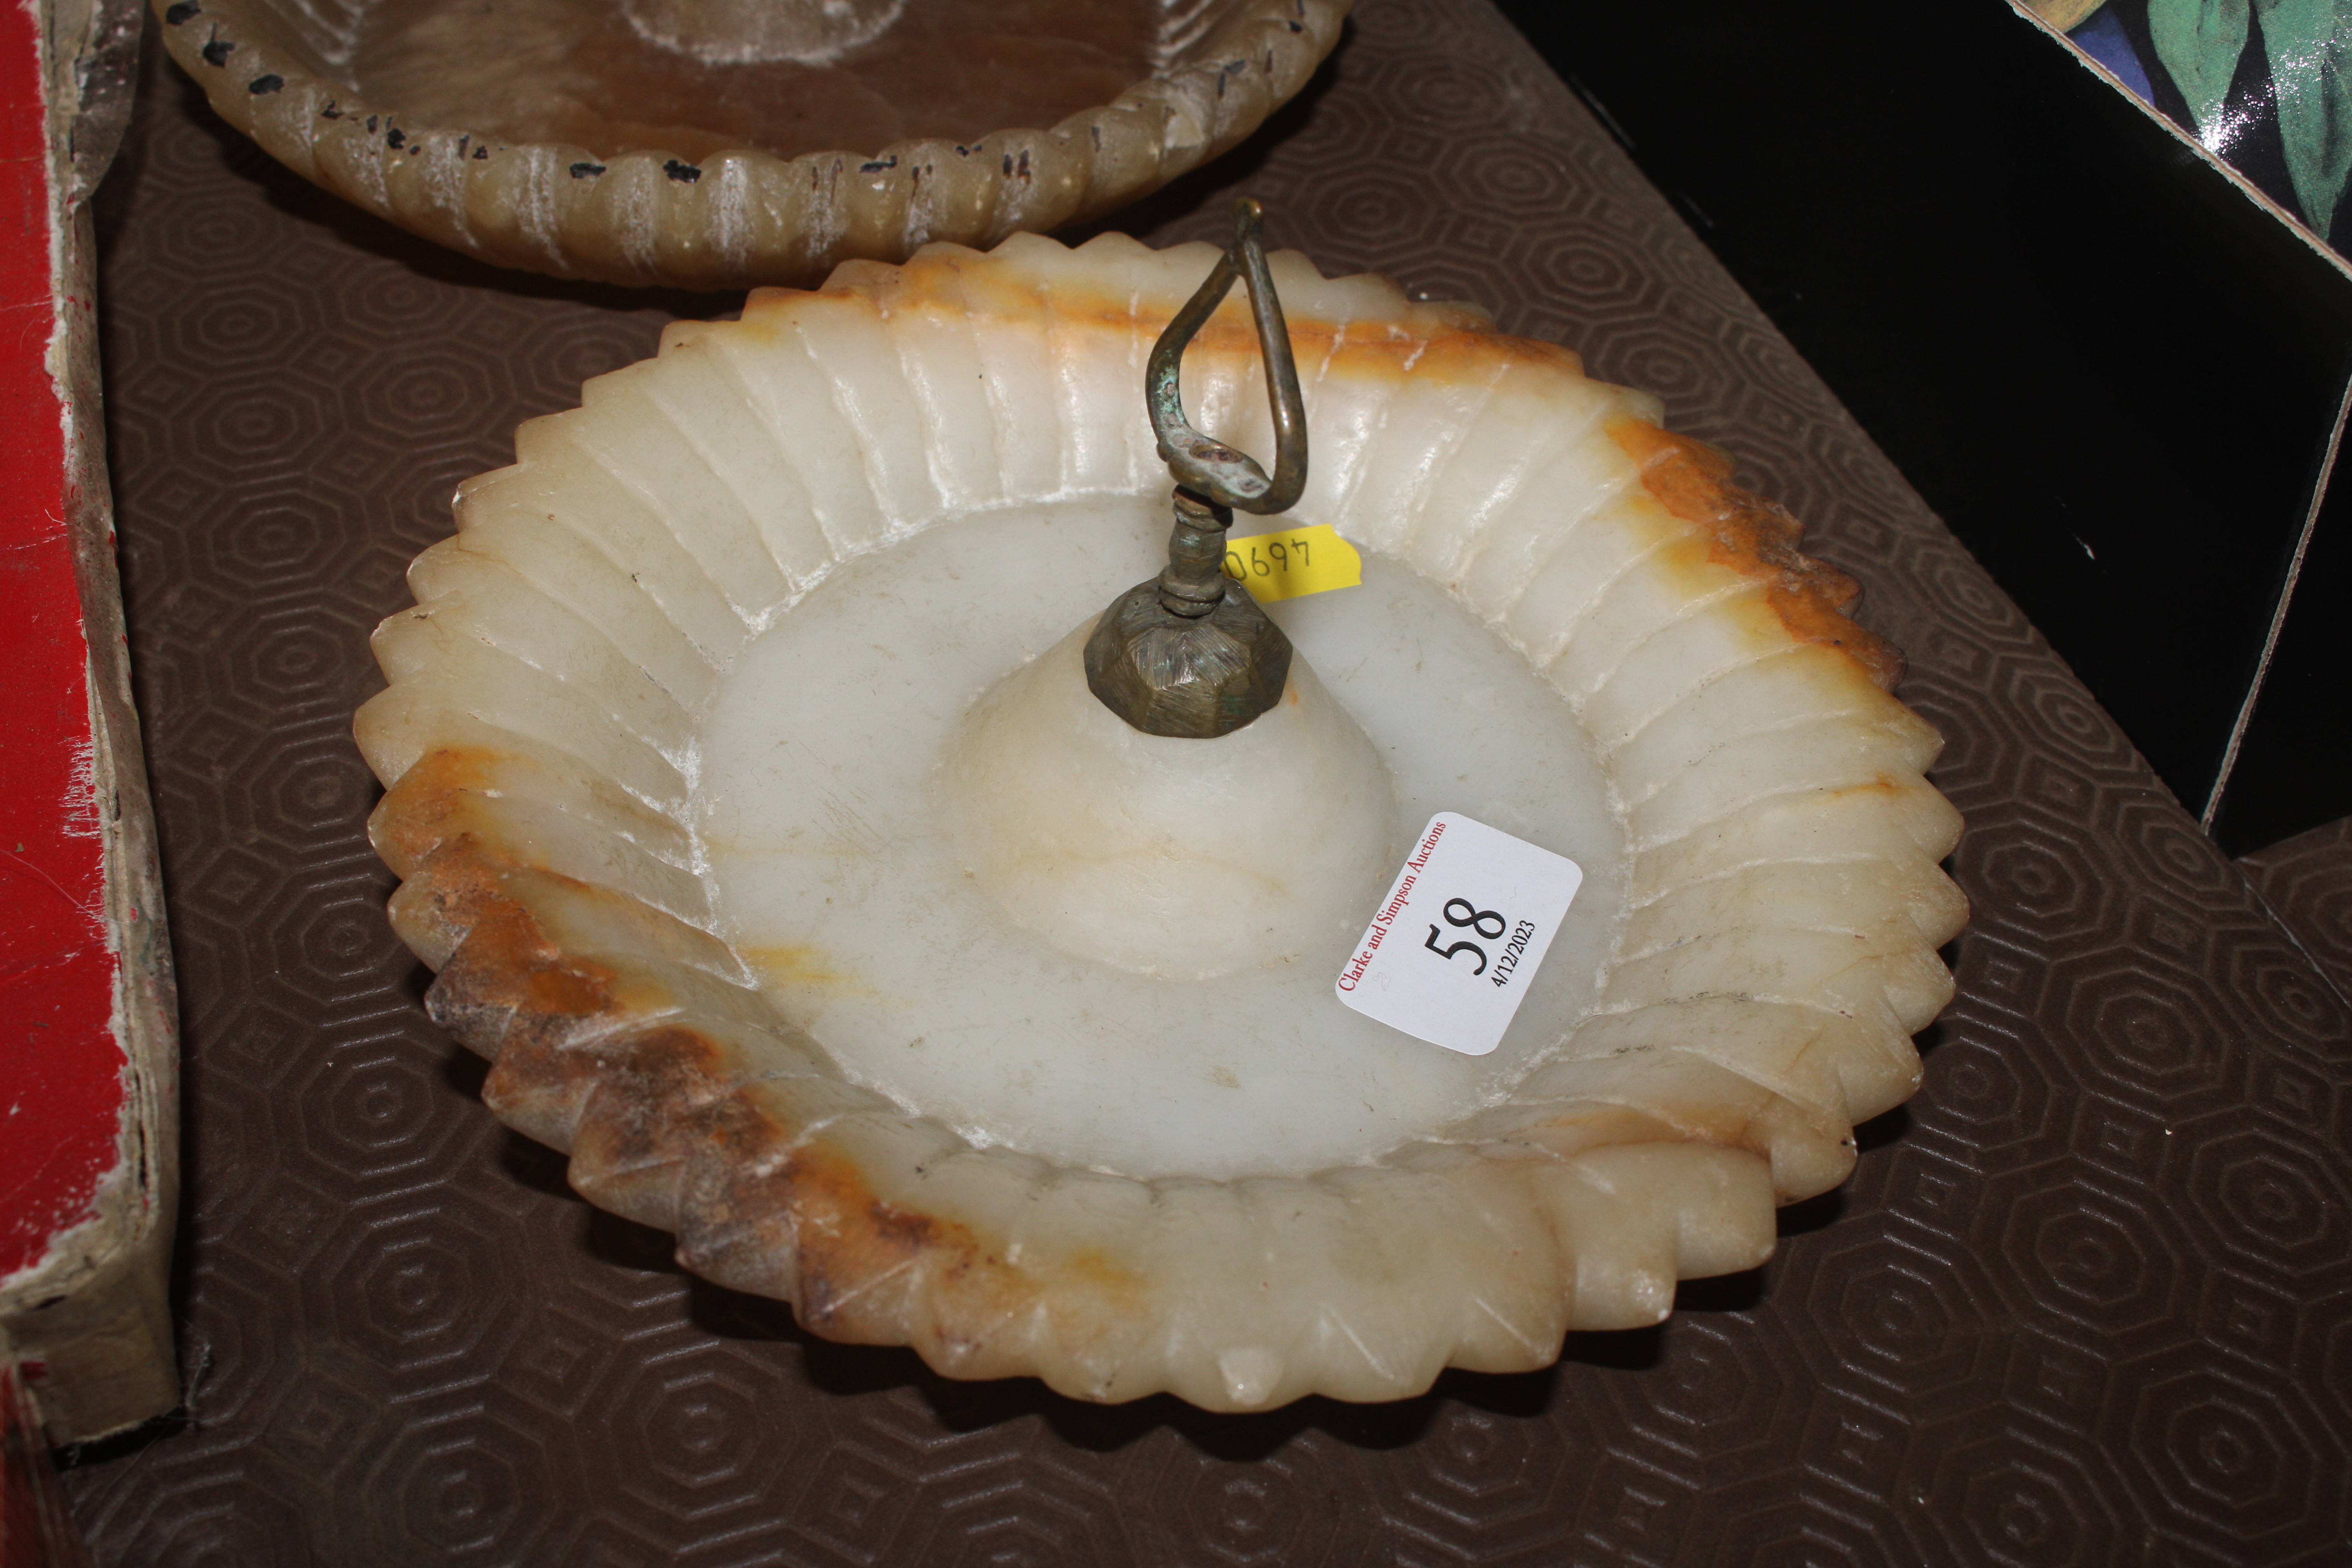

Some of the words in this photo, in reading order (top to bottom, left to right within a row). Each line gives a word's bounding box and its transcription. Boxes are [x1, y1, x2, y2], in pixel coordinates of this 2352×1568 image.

[1407, 822, 1446, 873] Auctions
[1376, 875, 1416, 925] Simpson
[1368, 924, 1388, 950] and
[1424, 898, 1506, 976] 58
[1491, 920, 1535, 987] 4/12/2023
[1338, 950, 1373, 991] Clarke
